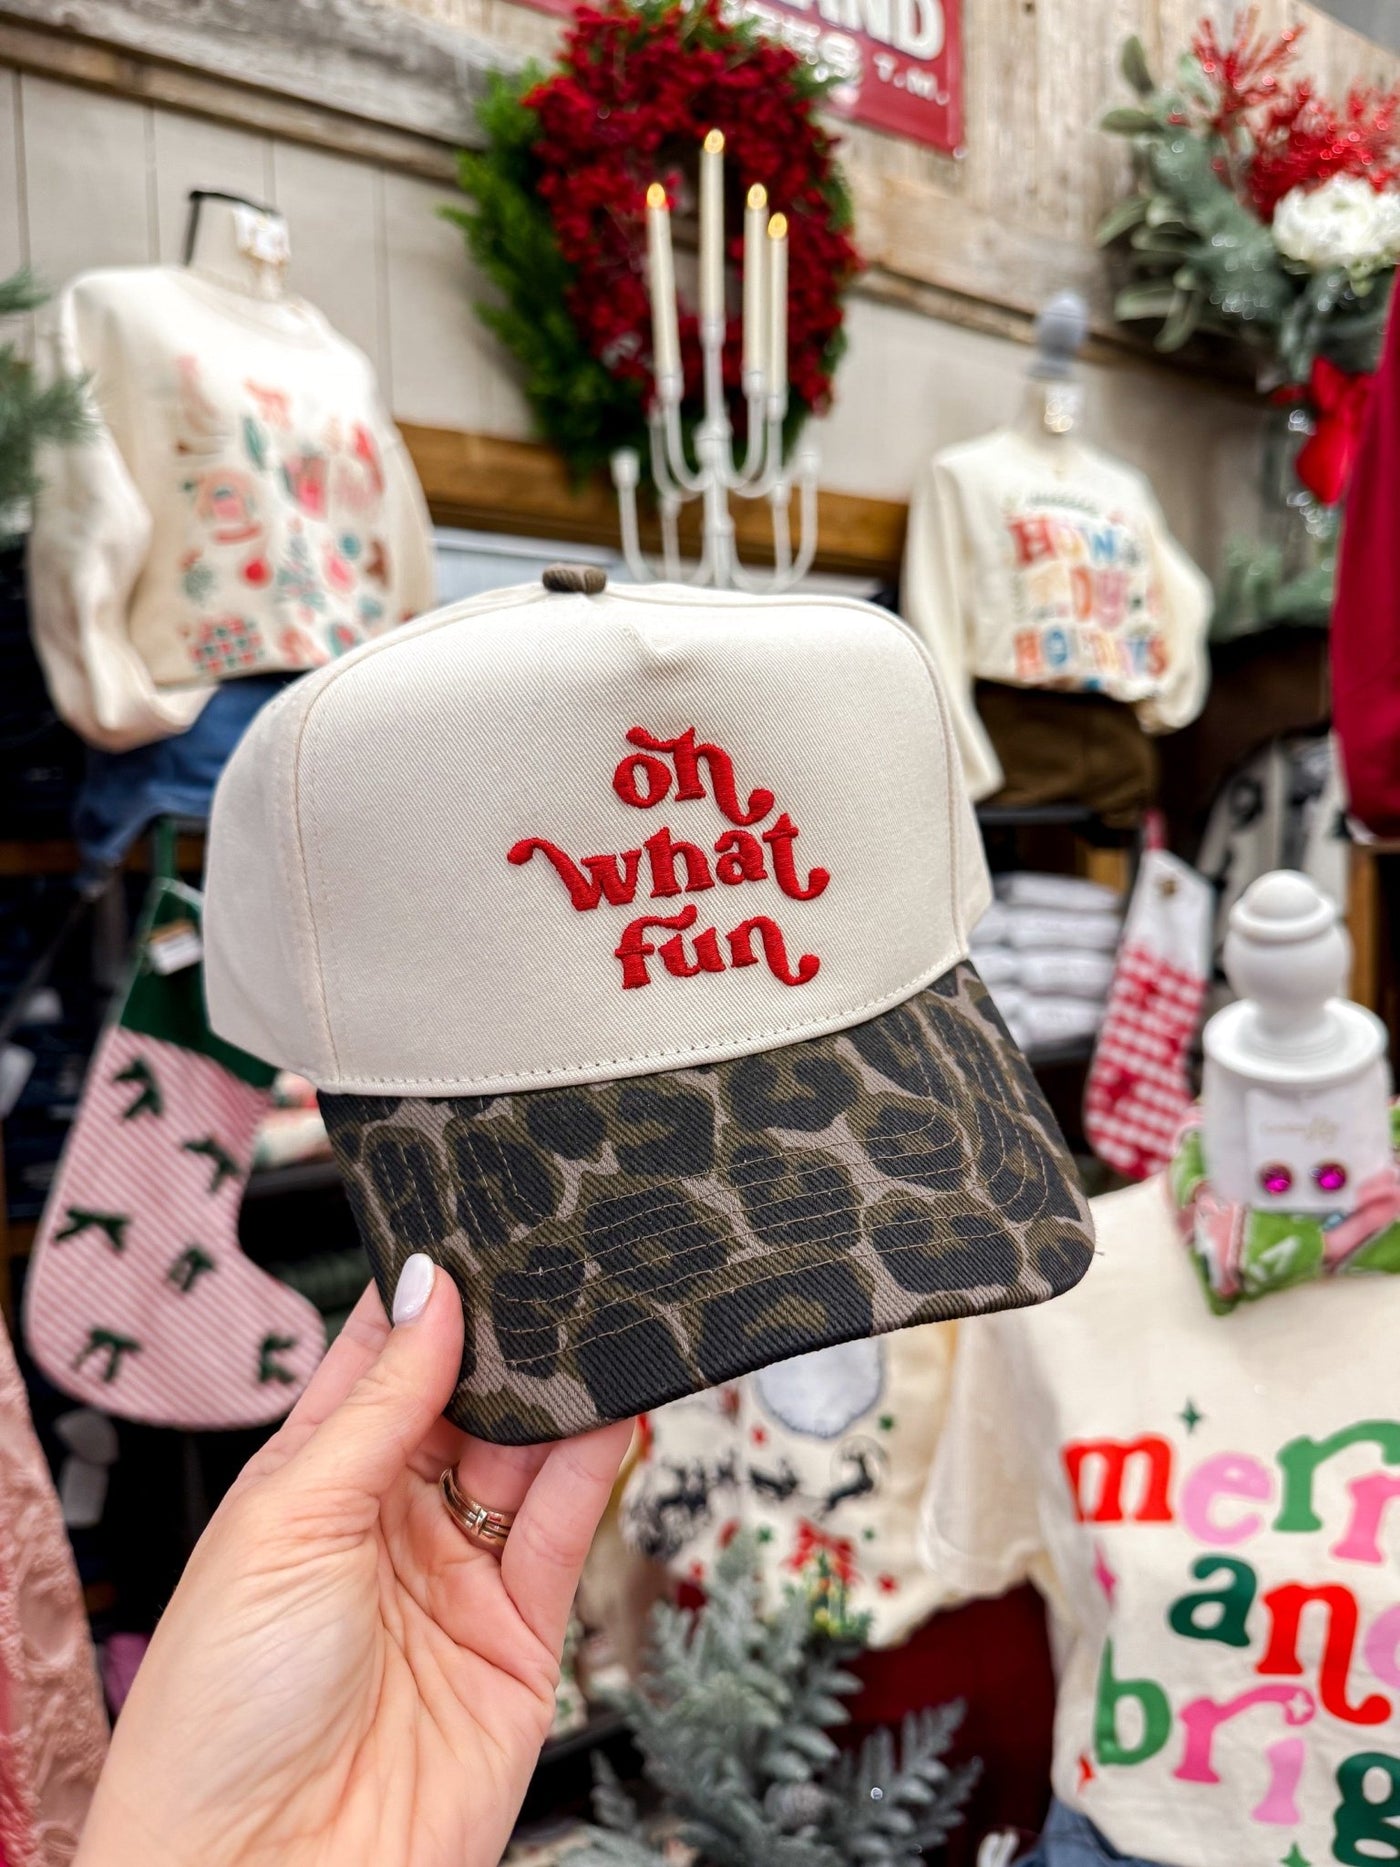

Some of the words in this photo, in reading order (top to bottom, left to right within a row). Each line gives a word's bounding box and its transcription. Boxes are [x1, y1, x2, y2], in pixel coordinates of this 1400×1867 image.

[612, 726, 775, 826] oh
[507, 812, 831, 911] what
[614, 903, 821, 990] fun
